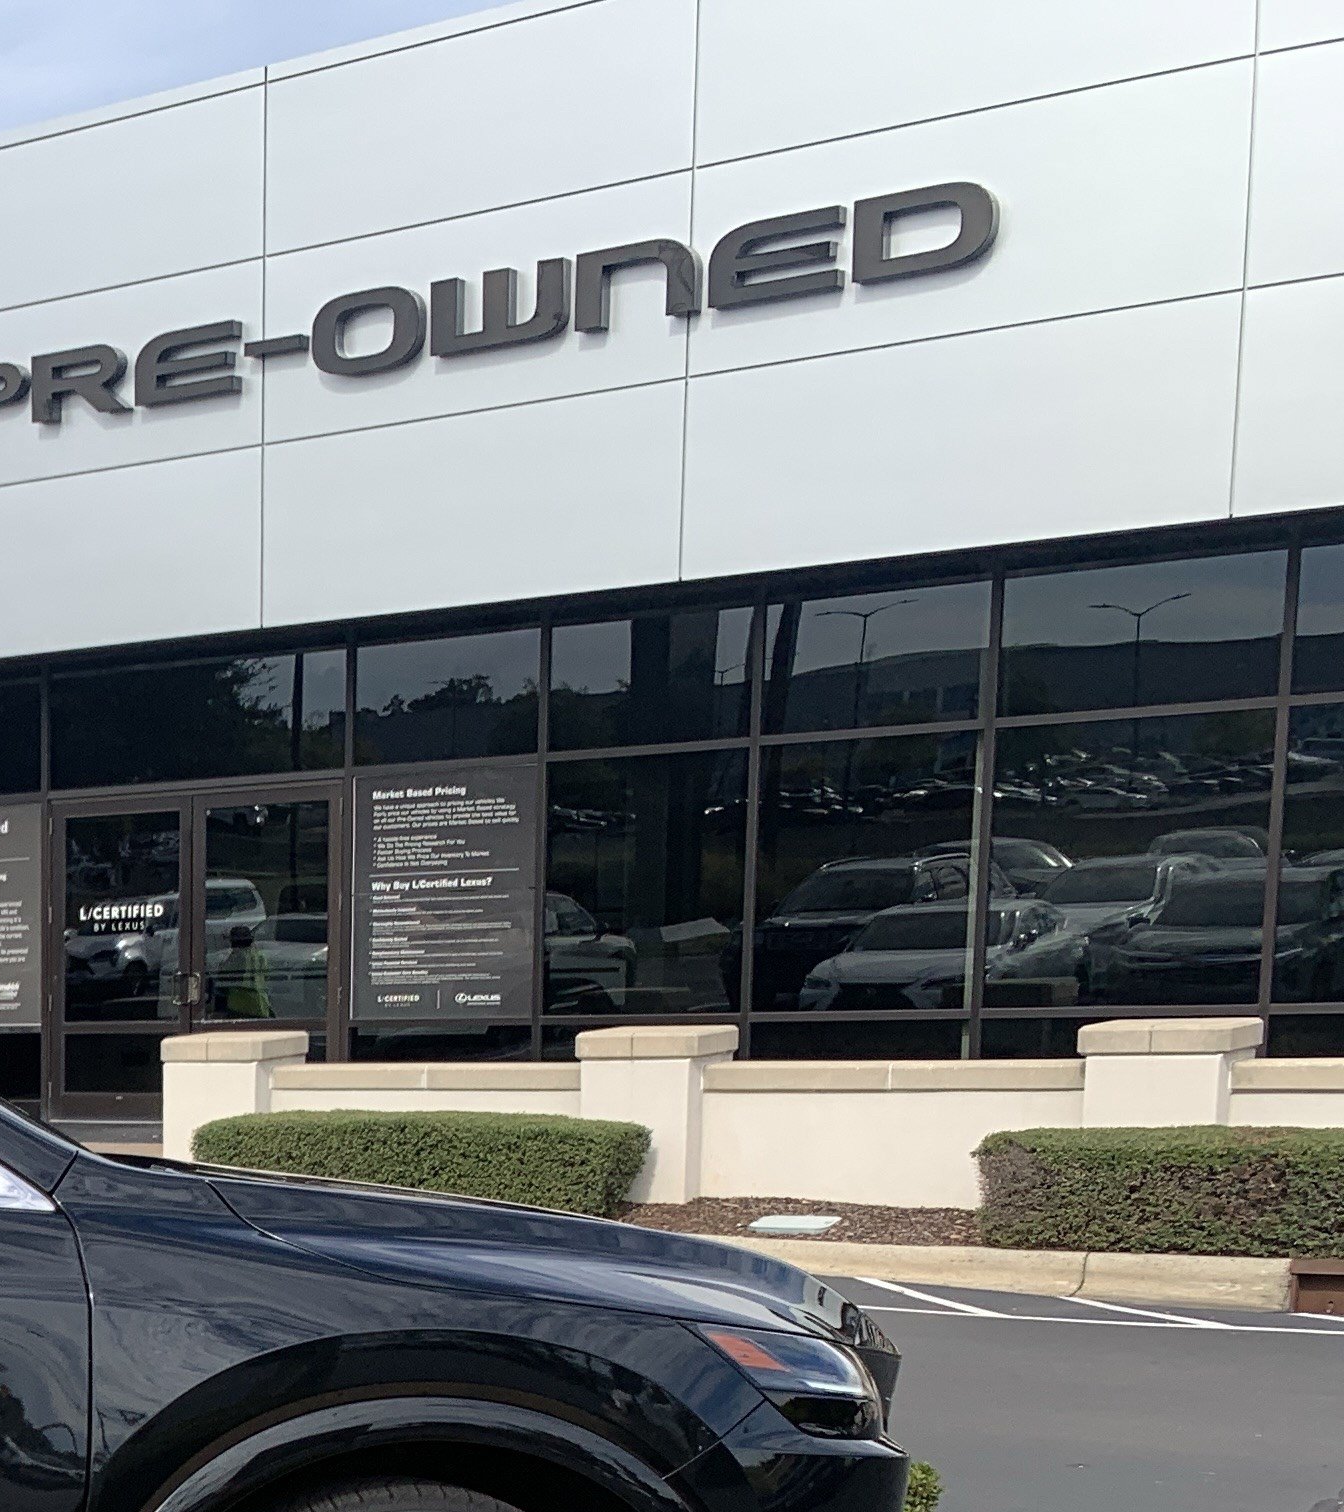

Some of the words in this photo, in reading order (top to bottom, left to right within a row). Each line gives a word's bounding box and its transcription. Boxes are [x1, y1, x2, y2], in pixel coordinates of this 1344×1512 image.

[372, 790, 405, 800] Market
[406, 788, 433, 798] Based
[435, 785, 466, 796] Pricing
[371, 880, 391, 892] Why
[393, 880, 410, 891] Buy
[460, 876, 493, 888] Lexus?
[79, 904, 164, 921] L/CERTIFIED
[93, 923, 106, 932] BY
[111, 921, 145, 931] LEXUS
